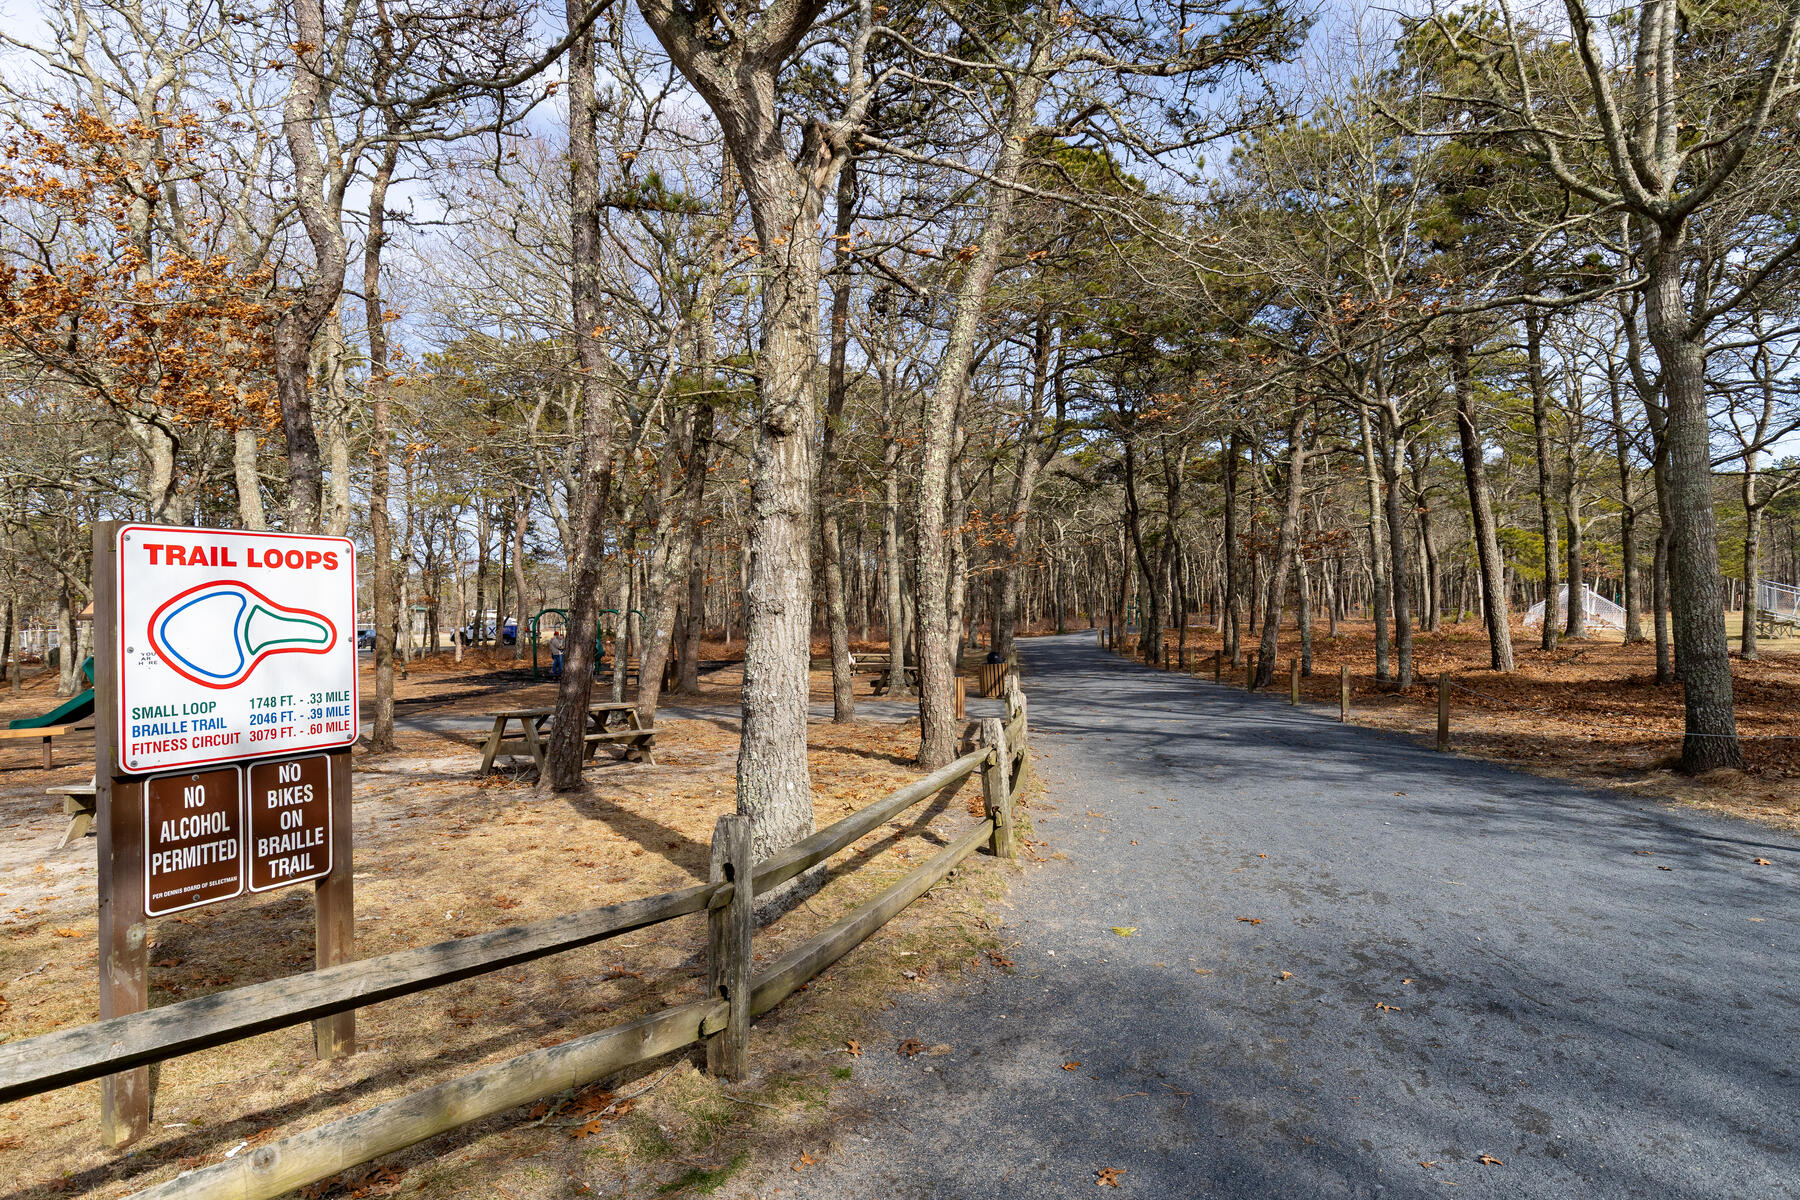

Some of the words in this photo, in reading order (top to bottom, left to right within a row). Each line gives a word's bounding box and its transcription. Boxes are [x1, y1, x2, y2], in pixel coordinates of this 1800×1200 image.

[143, 543, 237, 567] TRAIL
[247, 547, 339, 571] LOOPS
[132, 704, 179, 720] SMALL
[183, 701, 217, 716] LOOP
[249, 696, 277, 710] 1748
[280, 694, 296, 706] FT.
[307, 692, 322, 704] .33
[325, 690, 350, 703] MILE
[132, 720, 188, 738] BRAILLE
[191, 717, 228, 732] TRAIL
[249, 712, 277, 726] 2046
[280, 710, 297, 722] FT.
[307, 707, 323, 720] .39
[325, 705, 350, 718] MILE
[132, 737, 188, 756] FITNESS
[191, 731, 241, 749] CIRCUIT
[249, 728, 277, 742] 3079
[280, 726, 297, 739] FT.
[307, 723, 322, 736] .60
[325, 719, 350, 733] MILE
[278, 763, 302, 784] NO
[184, 784, 205, 809] NO
[267, 783, 314, 809] BIKES
[160, 811, 231, 844] ALCOHOL
[280, 809, 303, 830] ON
[258, 826, 324, 858] BRAILLE
[152, 838, 238, 876] PERMITTED
[268, 852, 315, 879] TRAIL
[152, 892, 164, 900] PER
[163, 887, 183, 897] DENNIS
[183, 883, 201, 893] BOARD
[201, 881, 209, 889] OF
[209, 875, 238, 887] SELECTMAN
